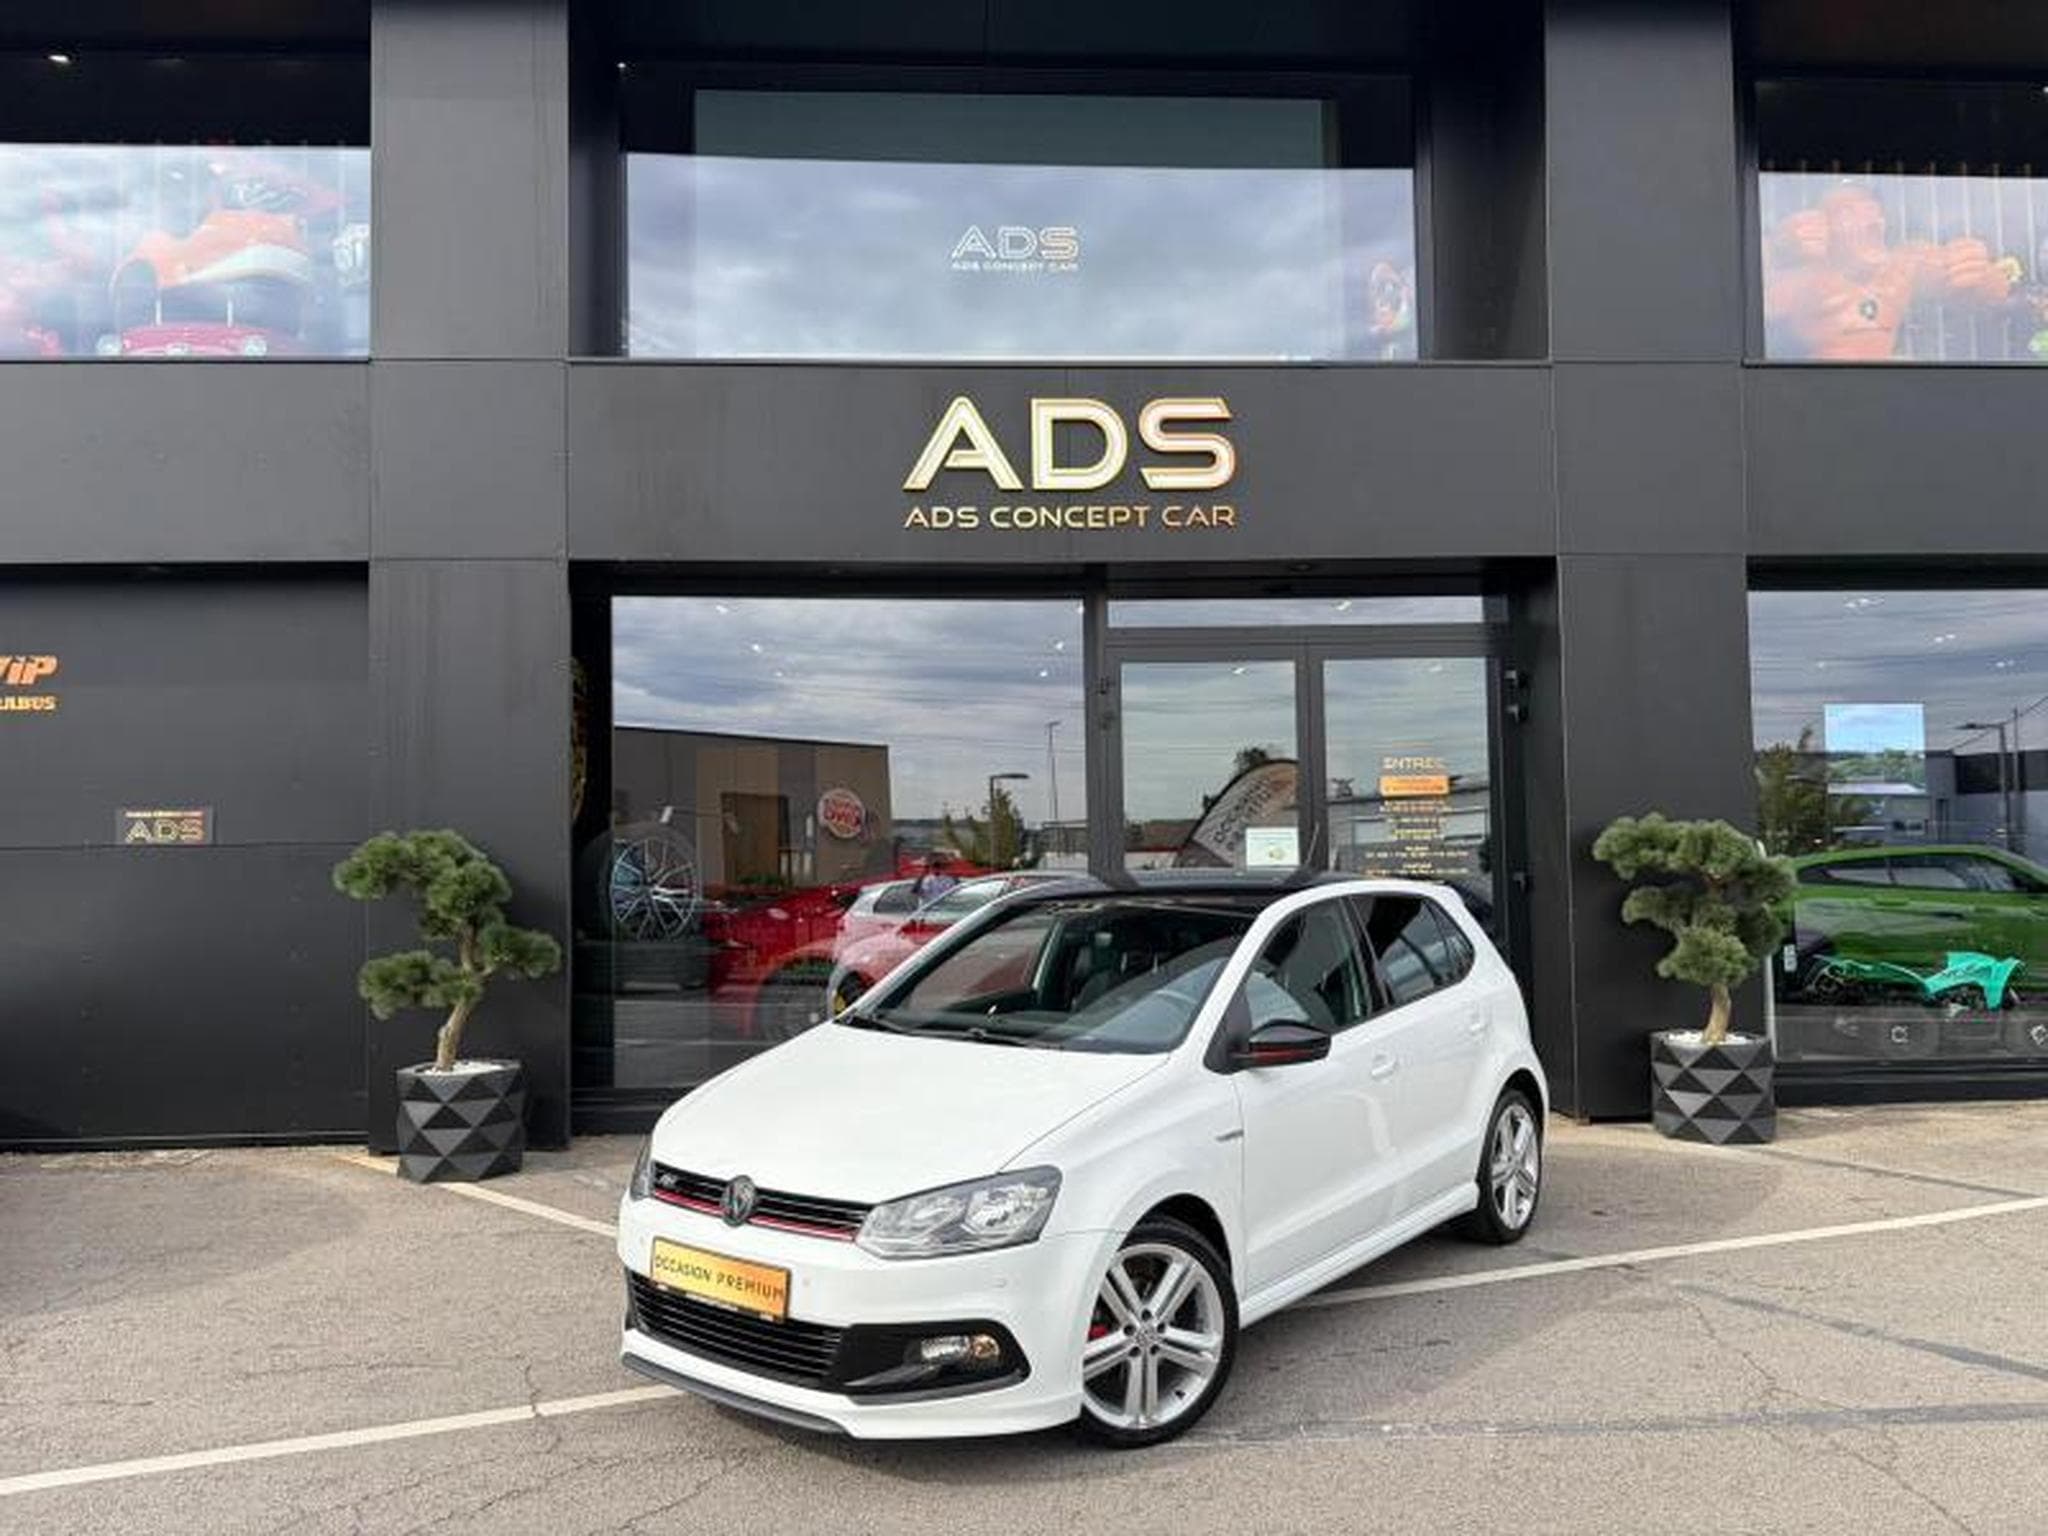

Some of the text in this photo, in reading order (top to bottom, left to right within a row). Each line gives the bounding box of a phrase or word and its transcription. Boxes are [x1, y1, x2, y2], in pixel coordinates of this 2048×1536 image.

[951, 225, 1079, 260] ADS
[902, 395, 1237, 492] ADS
[904, 504, 1236, 529] ADS CONCEPT CAR
[125, 819, 204, 843] ADS
[655, 1254, 784, 1302] OCCASION PREMIUM
